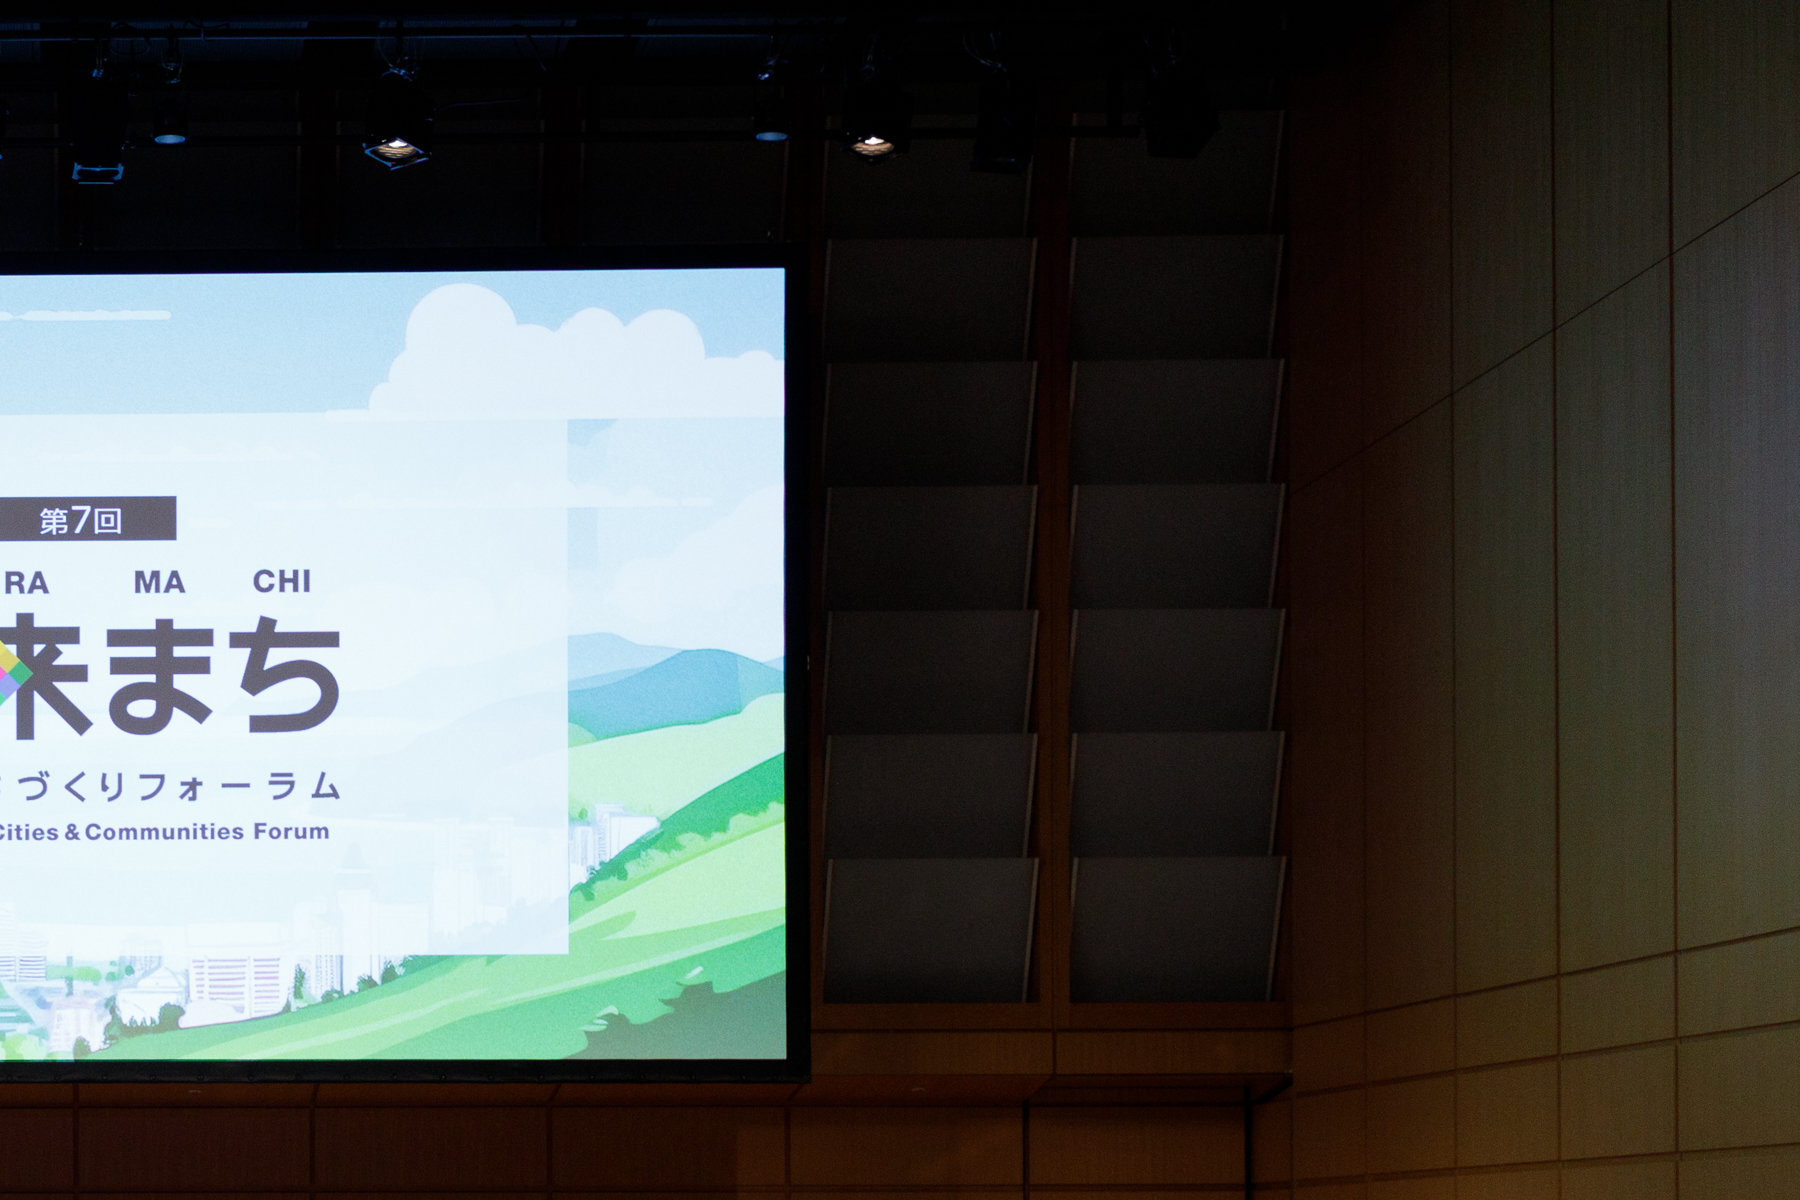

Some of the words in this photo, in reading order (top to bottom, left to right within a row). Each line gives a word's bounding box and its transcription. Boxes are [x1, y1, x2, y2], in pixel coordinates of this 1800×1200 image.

[39, 505, 122, 536] 第7回
[5, 570, 50, 594] RA
[134, 570, 186, 594] MA
[253, 568, 311, 593] CHI
[85, 822, 244, 841] Communities
[254, 822, 330, 840] Forum
